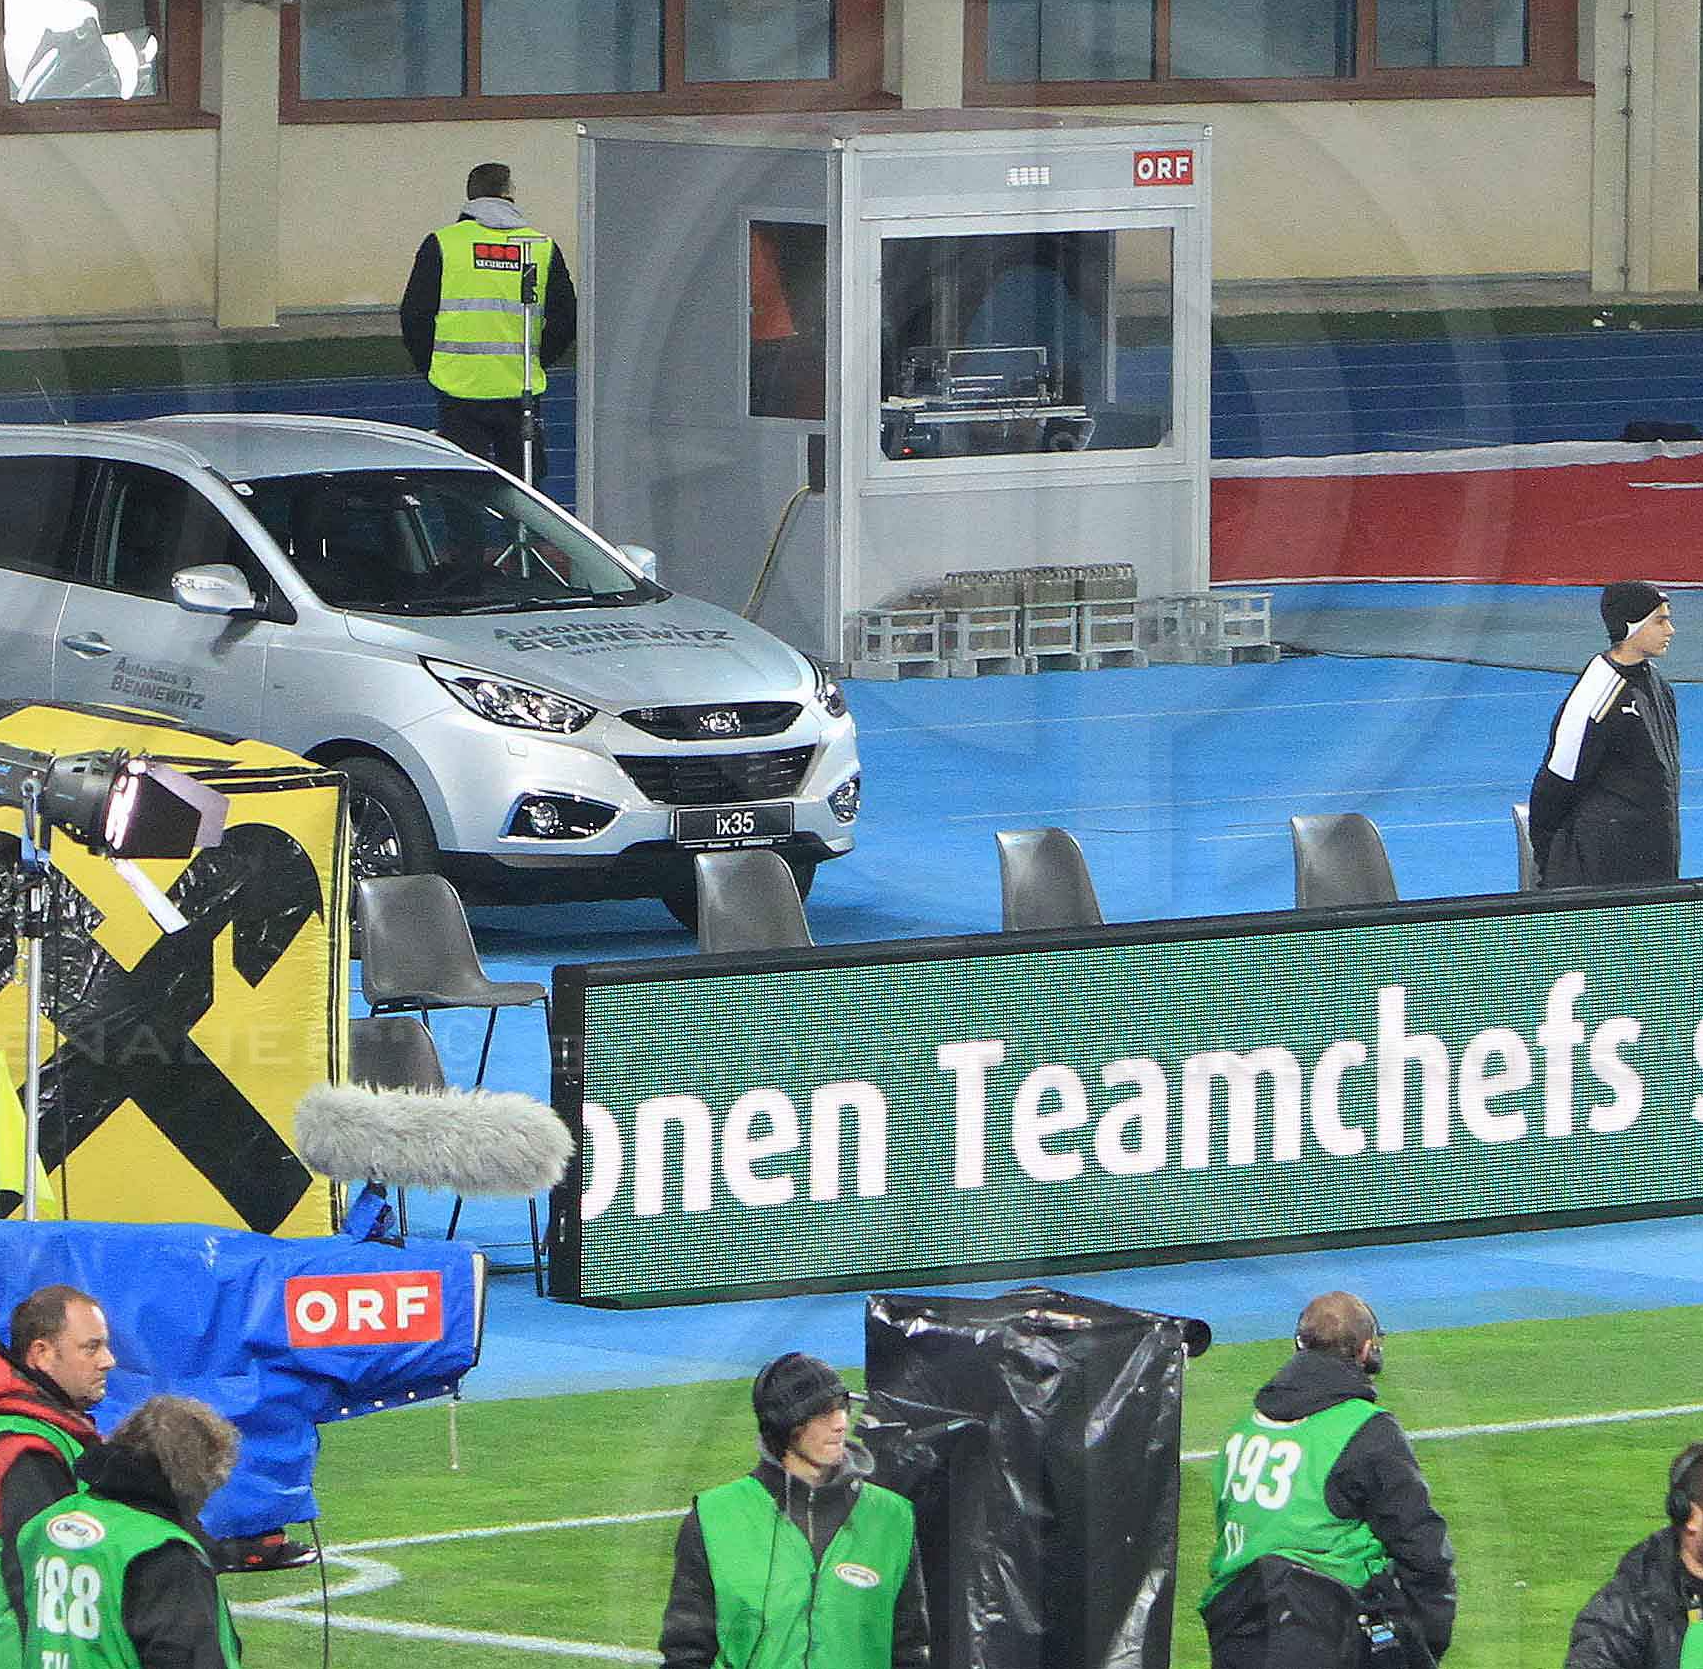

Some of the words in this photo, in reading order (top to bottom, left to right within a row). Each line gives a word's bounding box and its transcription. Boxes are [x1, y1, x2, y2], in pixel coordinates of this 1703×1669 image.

[1137, 157, 1191, 180] ORF
[715, 812, 756, 836] ix35
[937, 974, 1645, 1192] Teamchefs
[294, 1281, 430, 1337] ORF
[1221, 1439, 1296, 1511] 193
[34, 1554, 103, 1641] 188
